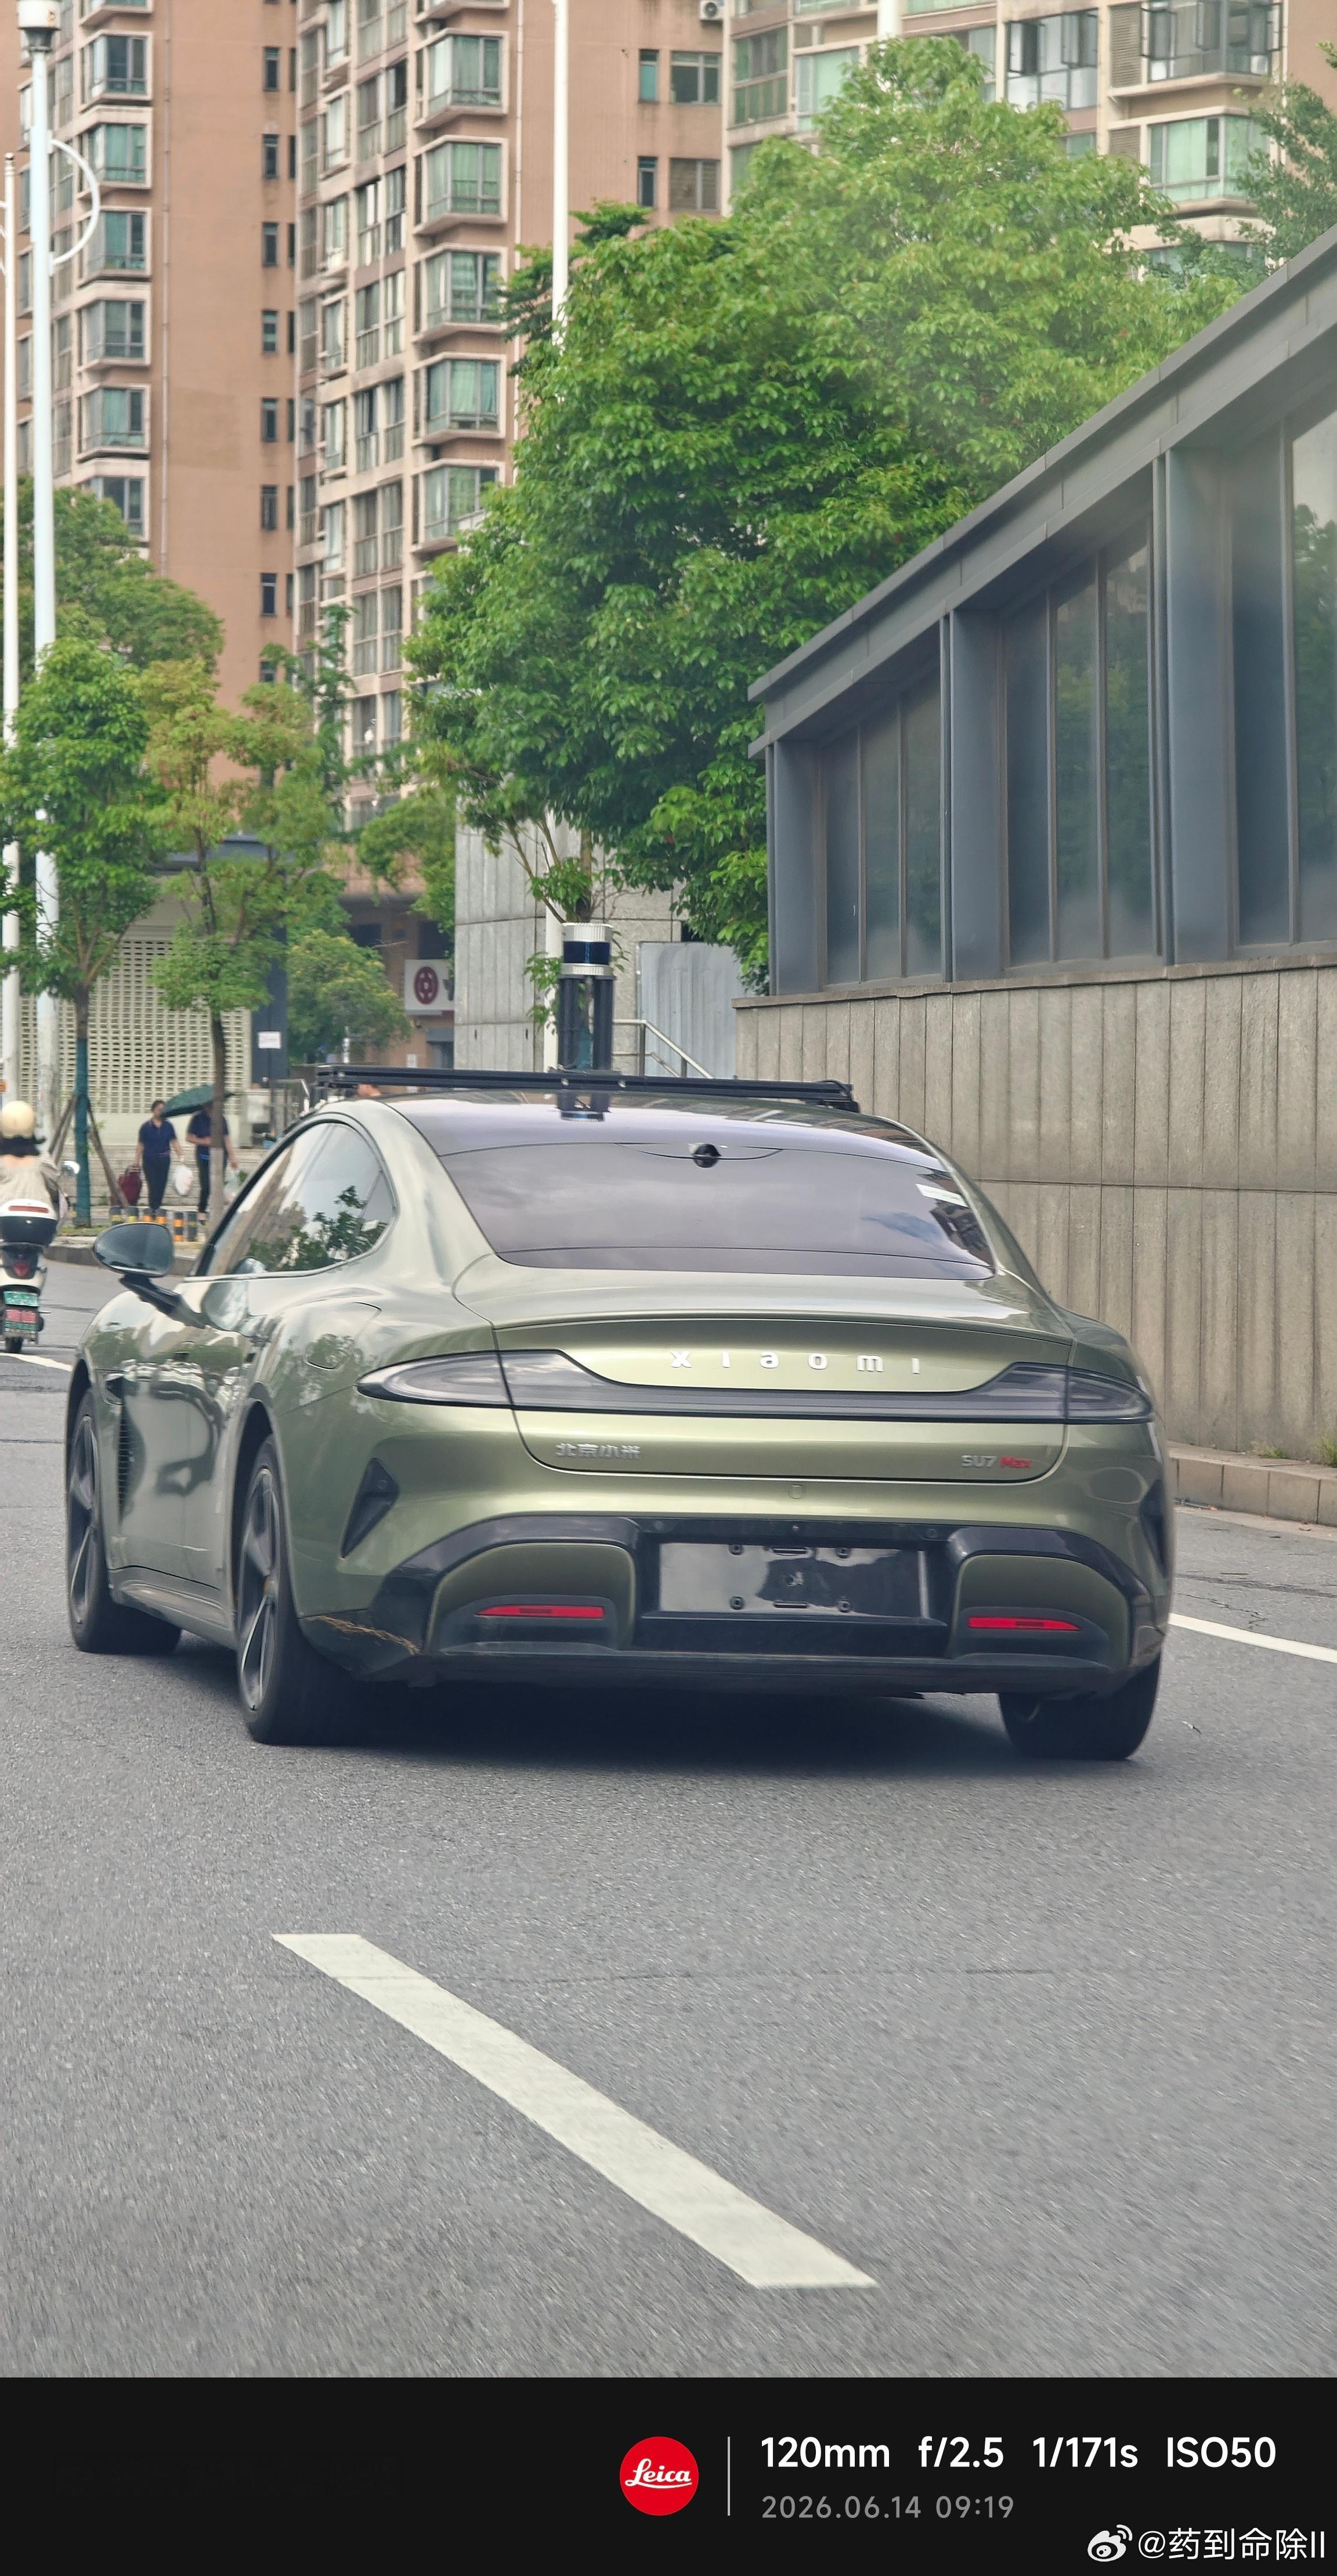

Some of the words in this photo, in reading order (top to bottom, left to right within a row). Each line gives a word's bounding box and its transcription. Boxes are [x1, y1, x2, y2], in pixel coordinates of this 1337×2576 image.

[555, 1442, 641, 1460] 北京小米
[961, 1455, 997, 1468] SU7
